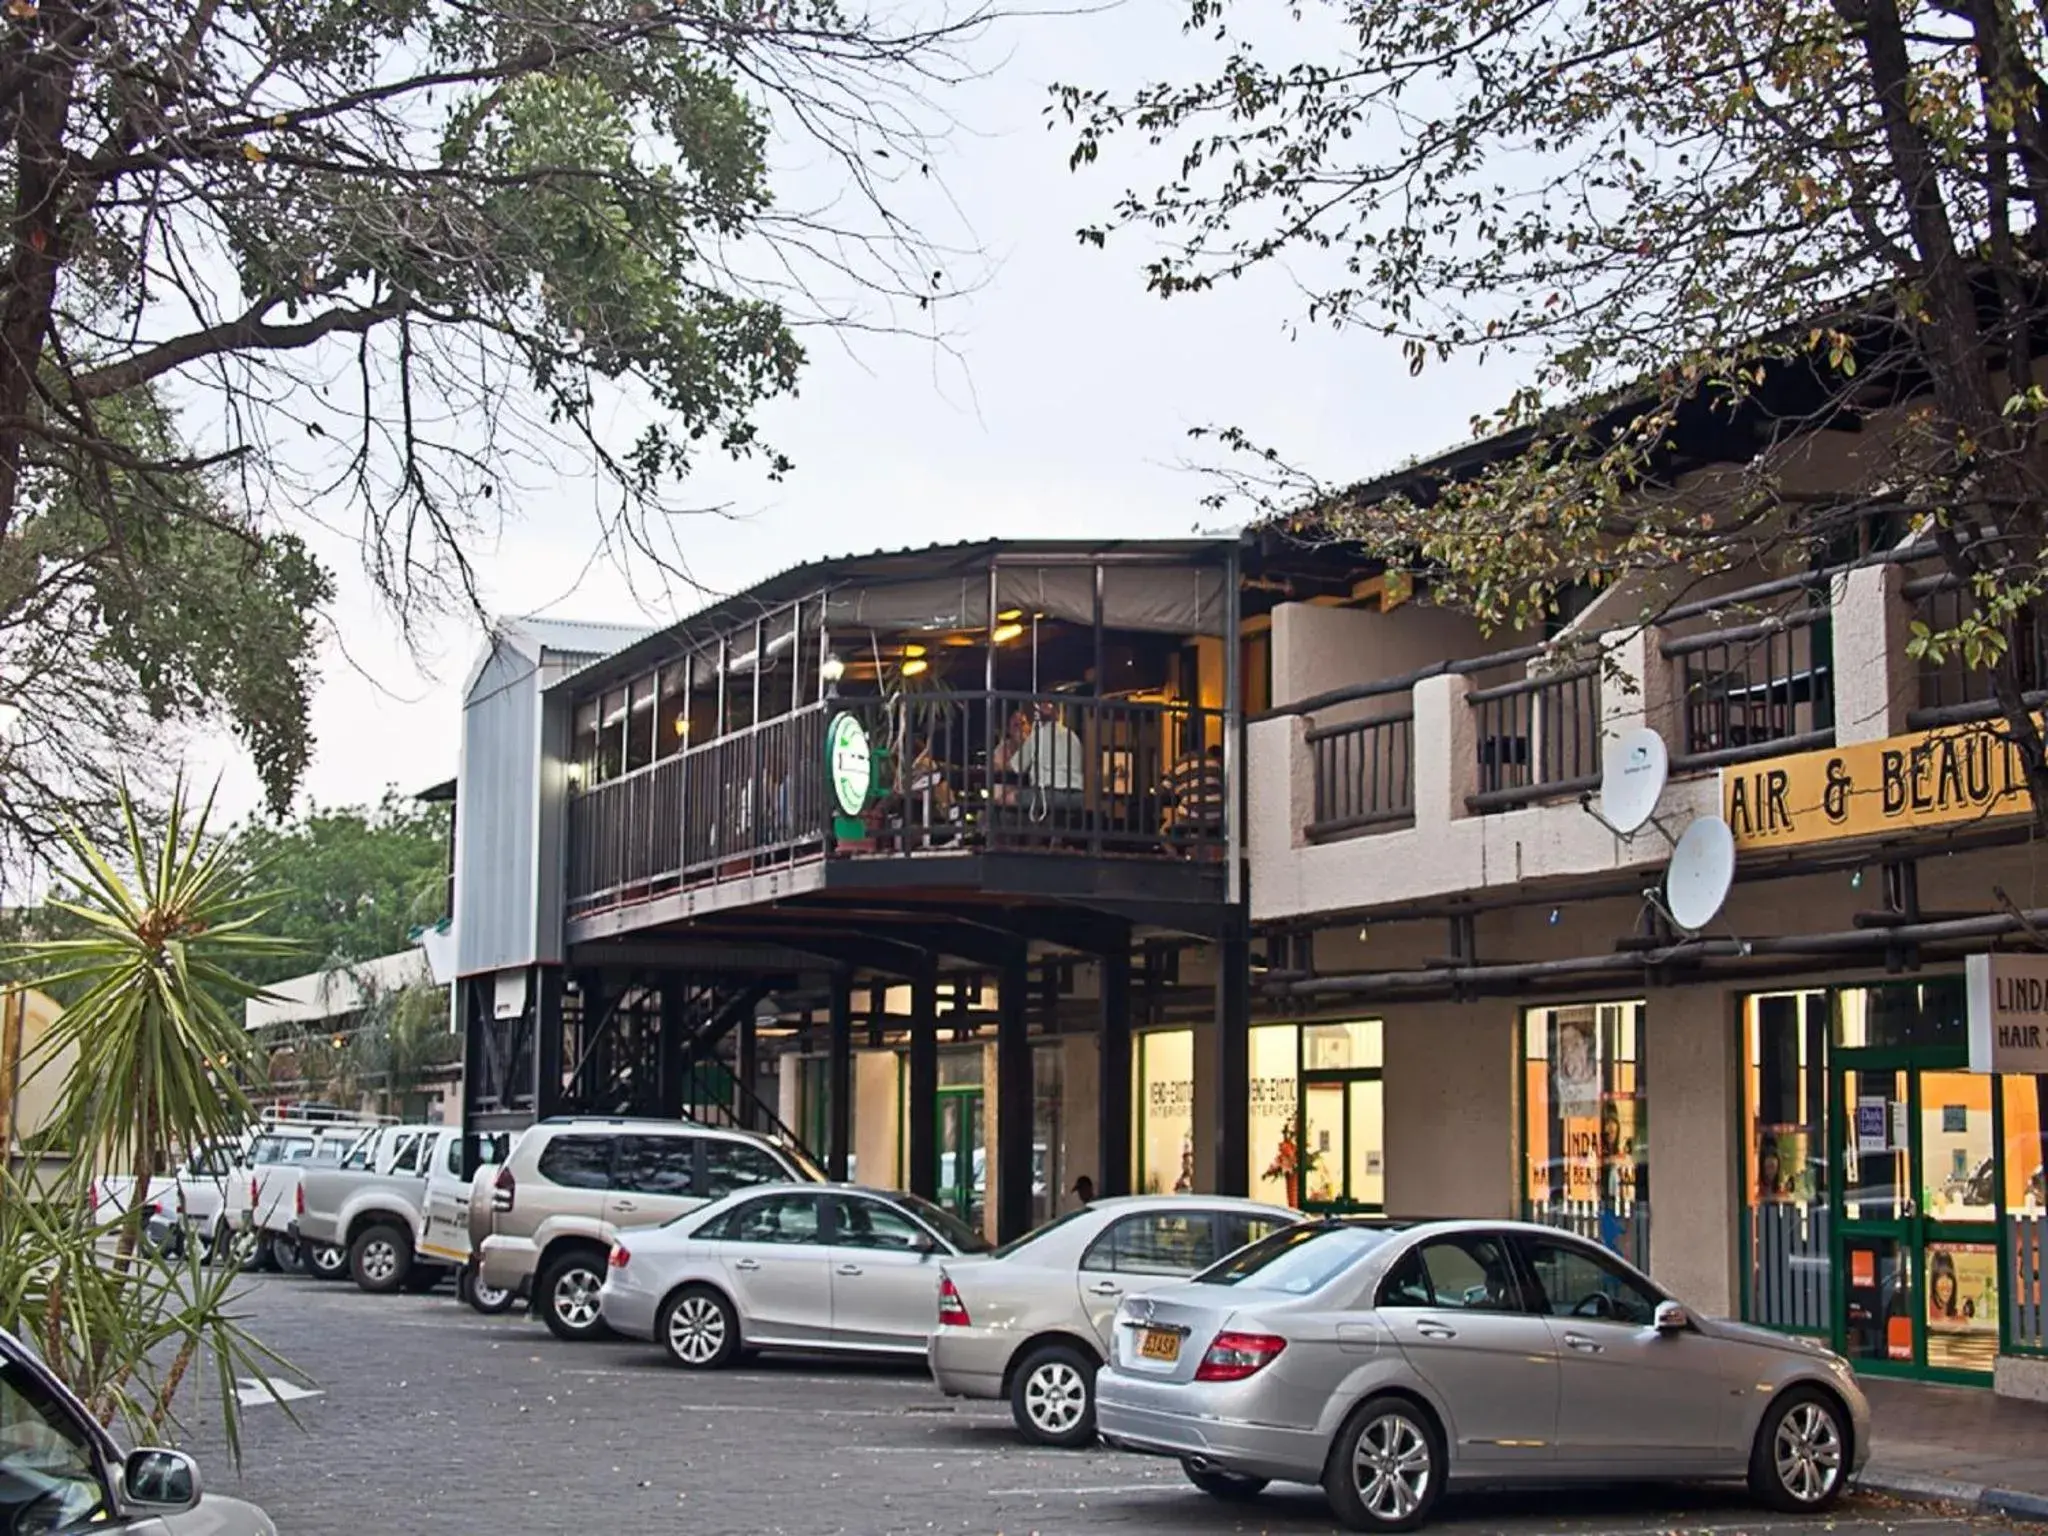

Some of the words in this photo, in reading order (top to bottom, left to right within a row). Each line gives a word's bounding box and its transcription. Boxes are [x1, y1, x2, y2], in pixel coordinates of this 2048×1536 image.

[1724, 768, 1796, 841] AIR
[1824, 757, 1853, 824] &
[1882, 732, 2020, 816] BEAUT
[1998, 1025, 2042, 1049] HAIR
